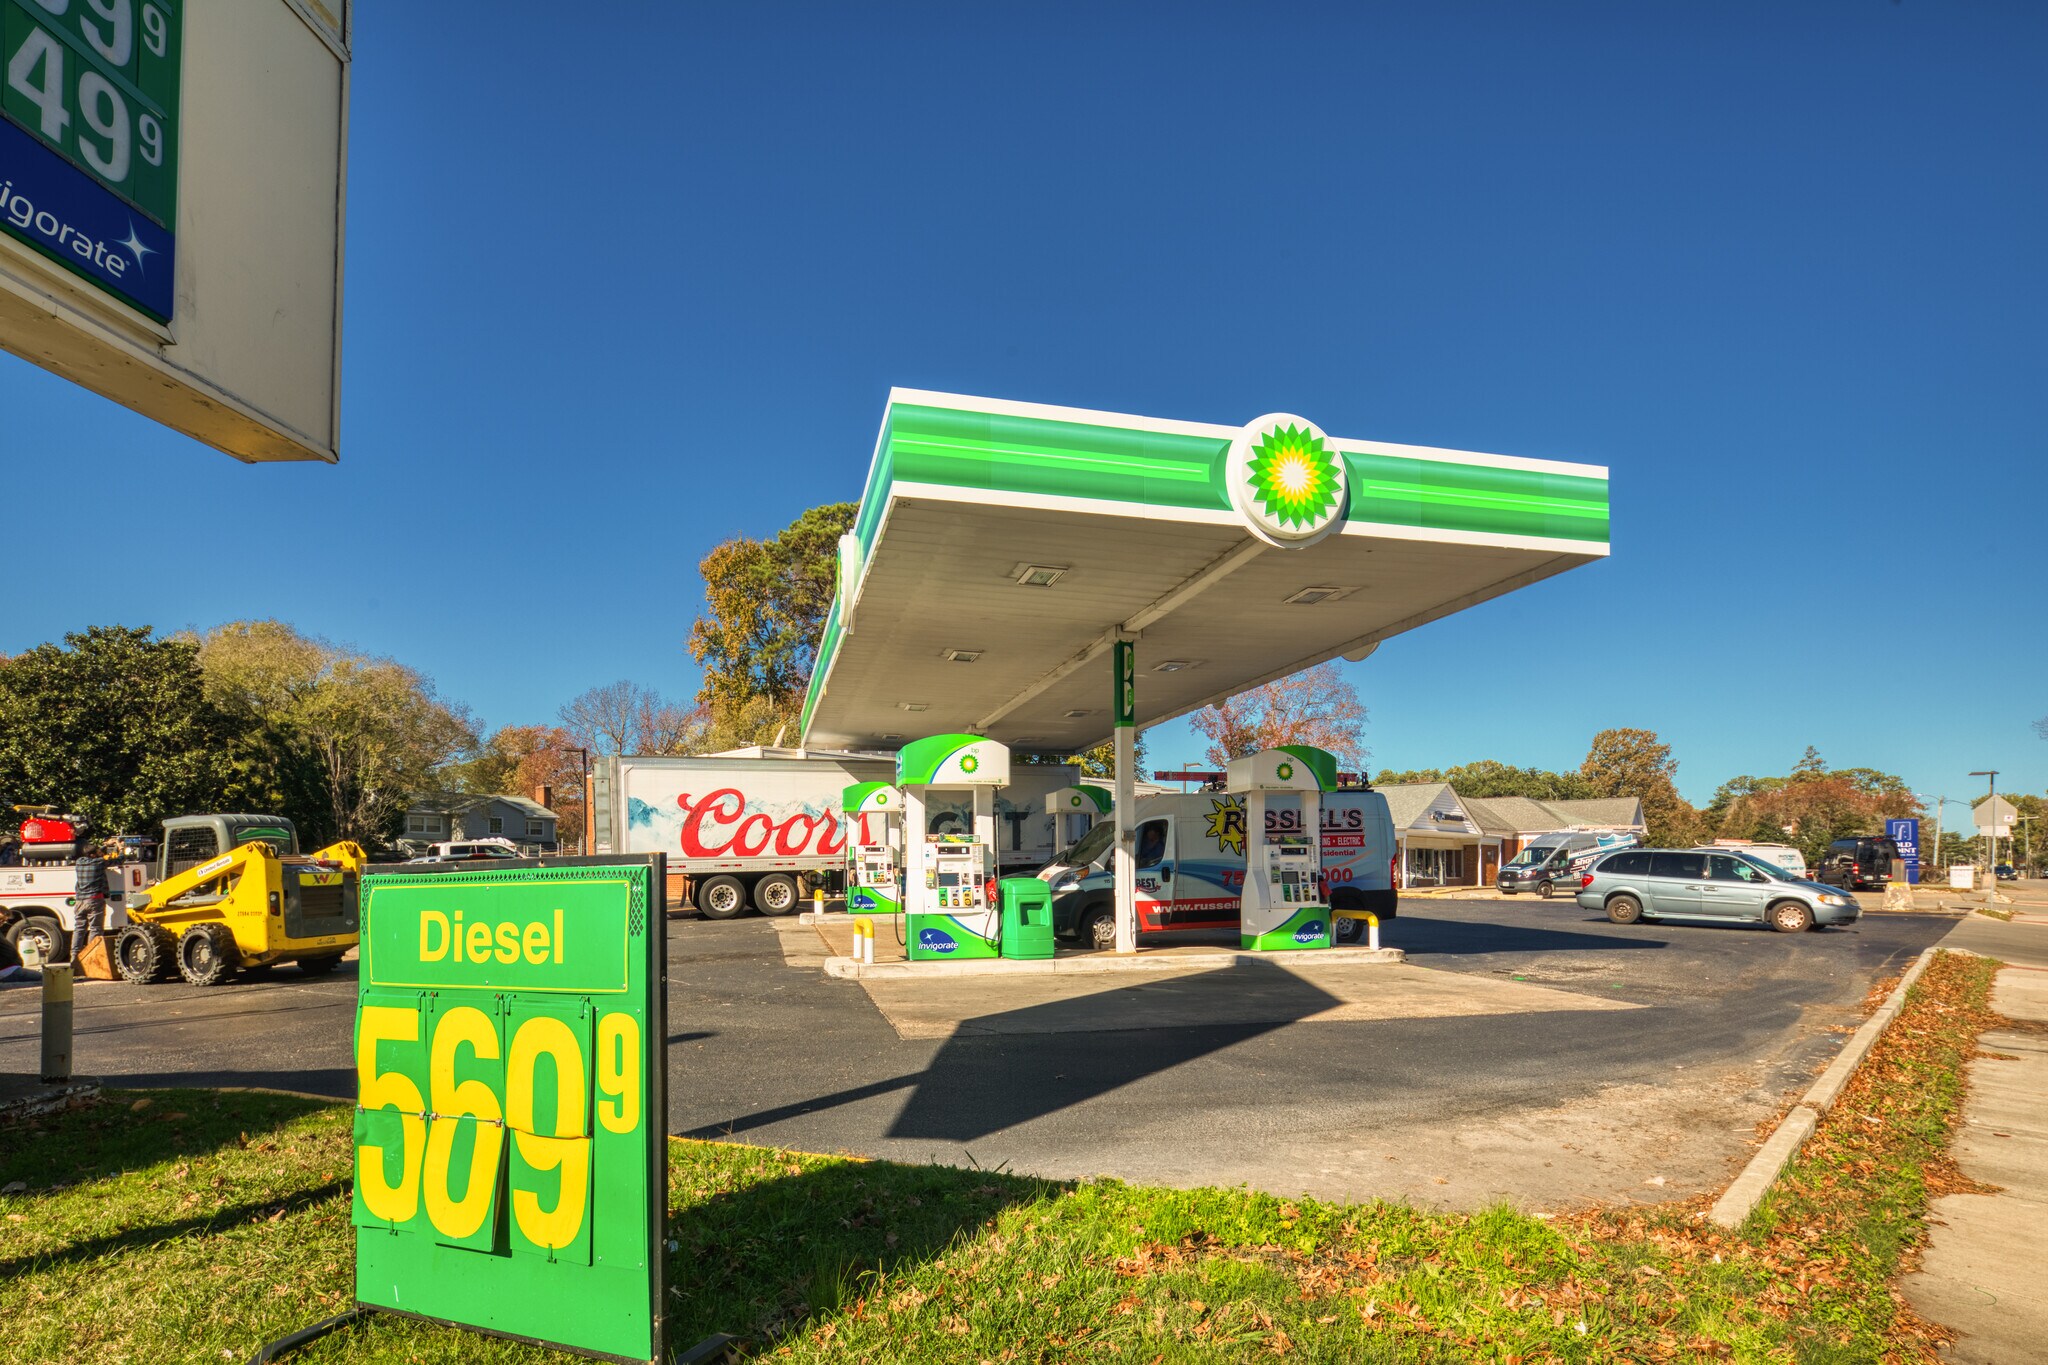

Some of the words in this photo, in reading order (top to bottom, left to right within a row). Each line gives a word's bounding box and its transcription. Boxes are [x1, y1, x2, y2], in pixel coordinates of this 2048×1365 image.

[0, 180, 126, 278] igorate
[1337, 836, 1361, 846] ELECTRIC
[1321, 849, 1357, 857] sidential
[1151, 899, 1241, 914] www.russell
[419, 908, 564, 966] Diesel
